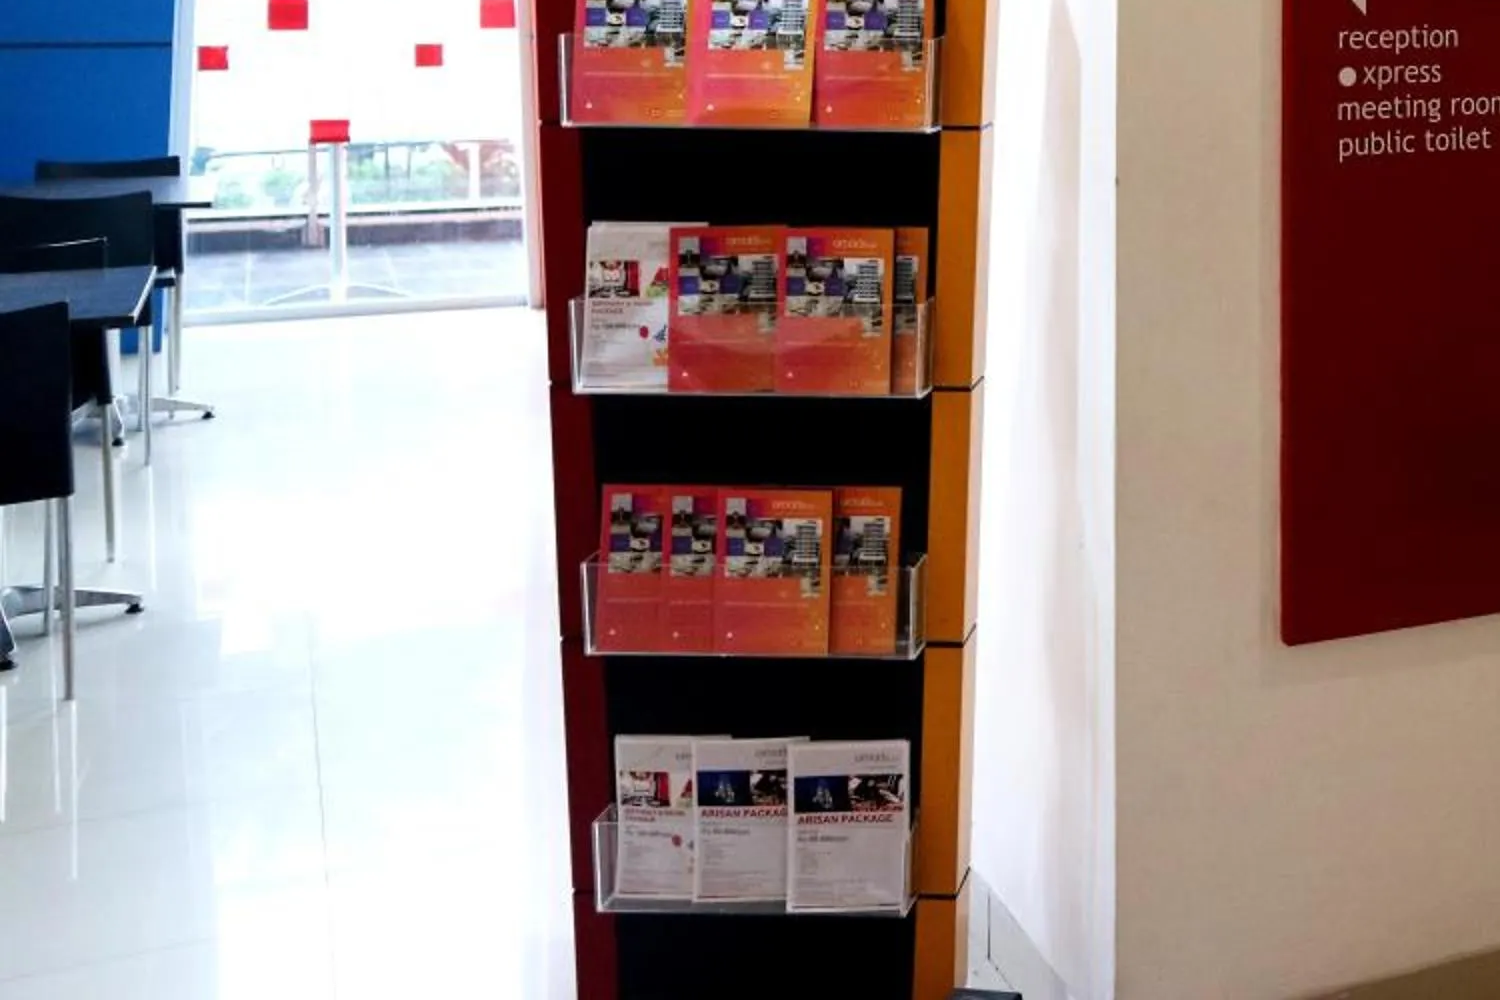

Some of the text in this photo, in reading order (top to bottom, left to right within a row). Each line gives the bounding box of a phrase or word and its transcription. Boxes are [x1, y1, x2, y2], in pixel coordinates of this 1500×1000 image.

[1338, 24, 1459, 55] reception
[1363, 63, 1442, 87] xpress
[1337, 93, 1441, 123] meeting
[1339, 125, 1492, 163] public toilet
[743, 808, 787, 817] PACKAG
[841, 814, 894, 823] PACKAGE
